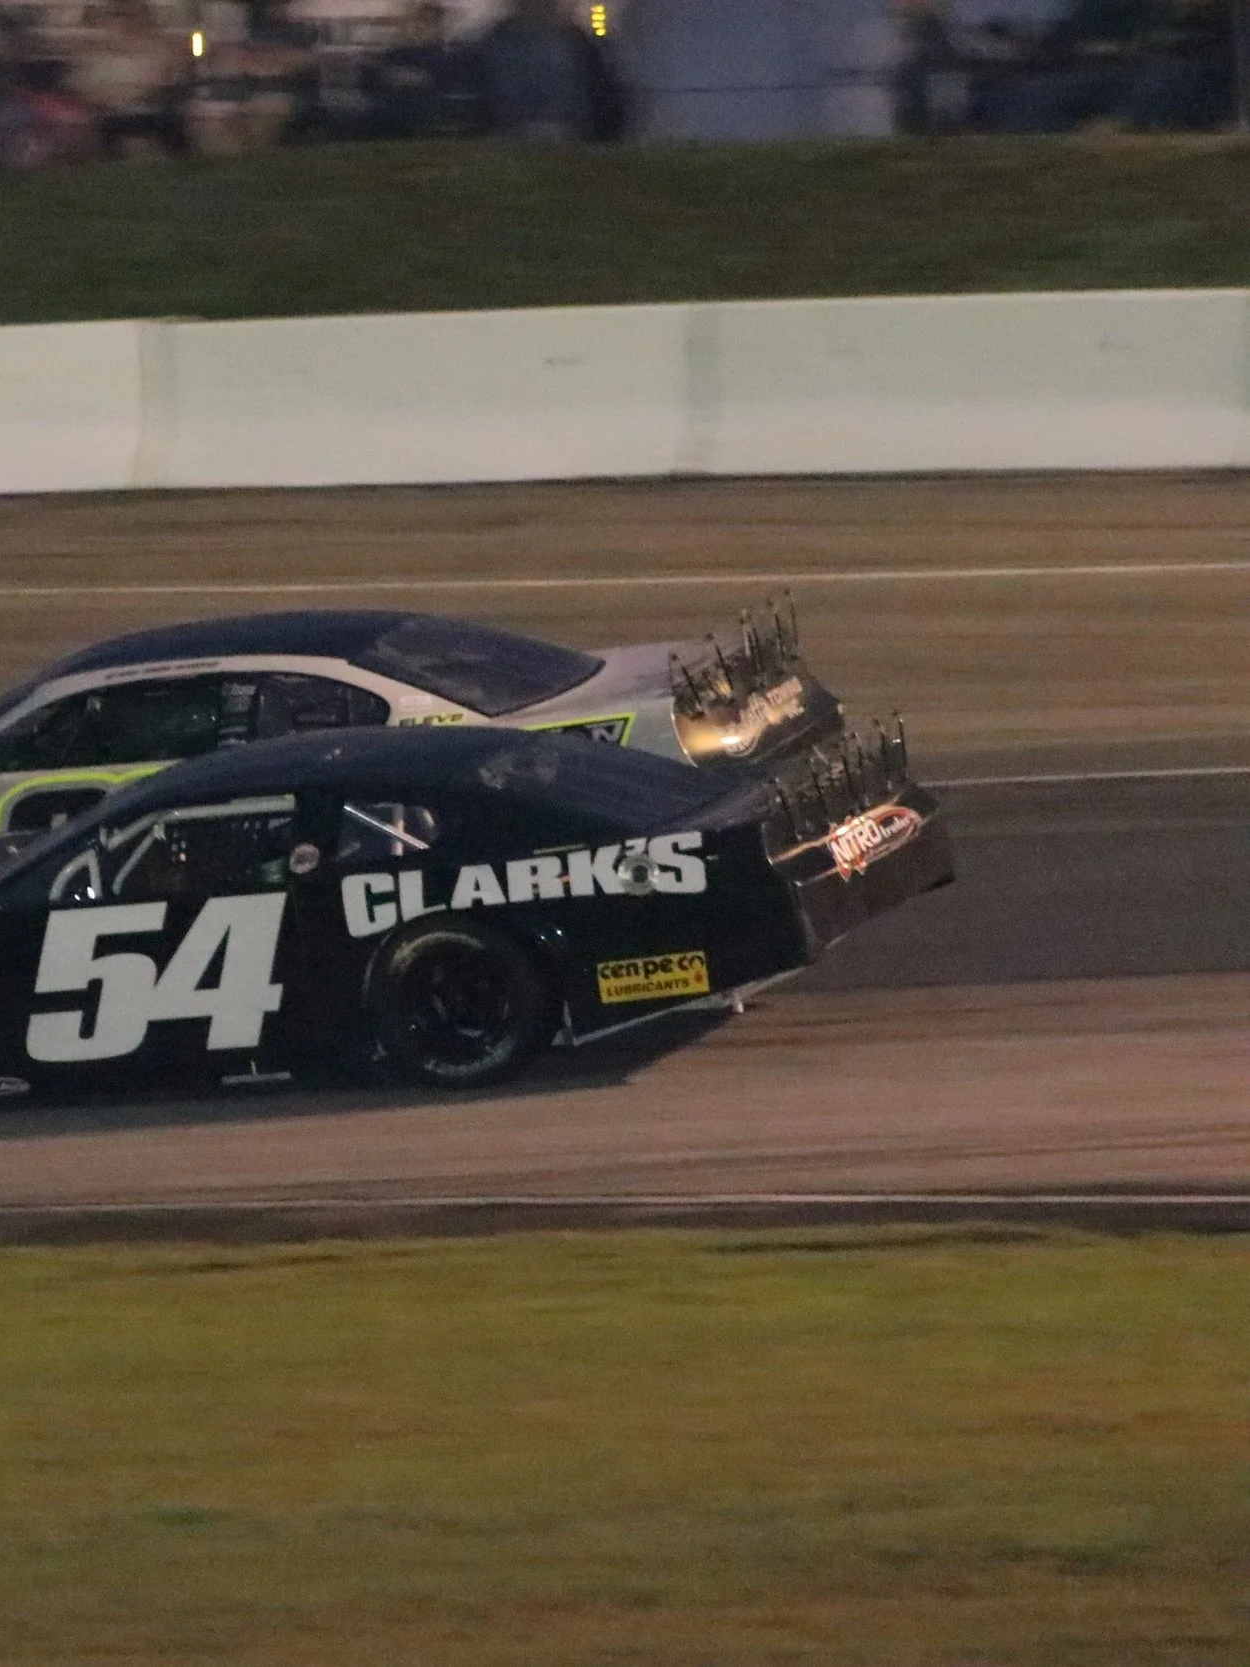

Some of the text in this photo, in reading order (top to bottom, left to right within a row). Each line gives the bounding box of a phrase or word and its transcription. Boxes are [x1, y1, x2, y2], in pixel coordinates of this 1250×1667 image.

[829, 818, 883, 862] NITRO
[341, 831, 707, 939] CLARK'S
[26, 891, 287, 1062] 54
[606, 978, 690, 996] LUBRICANTS
